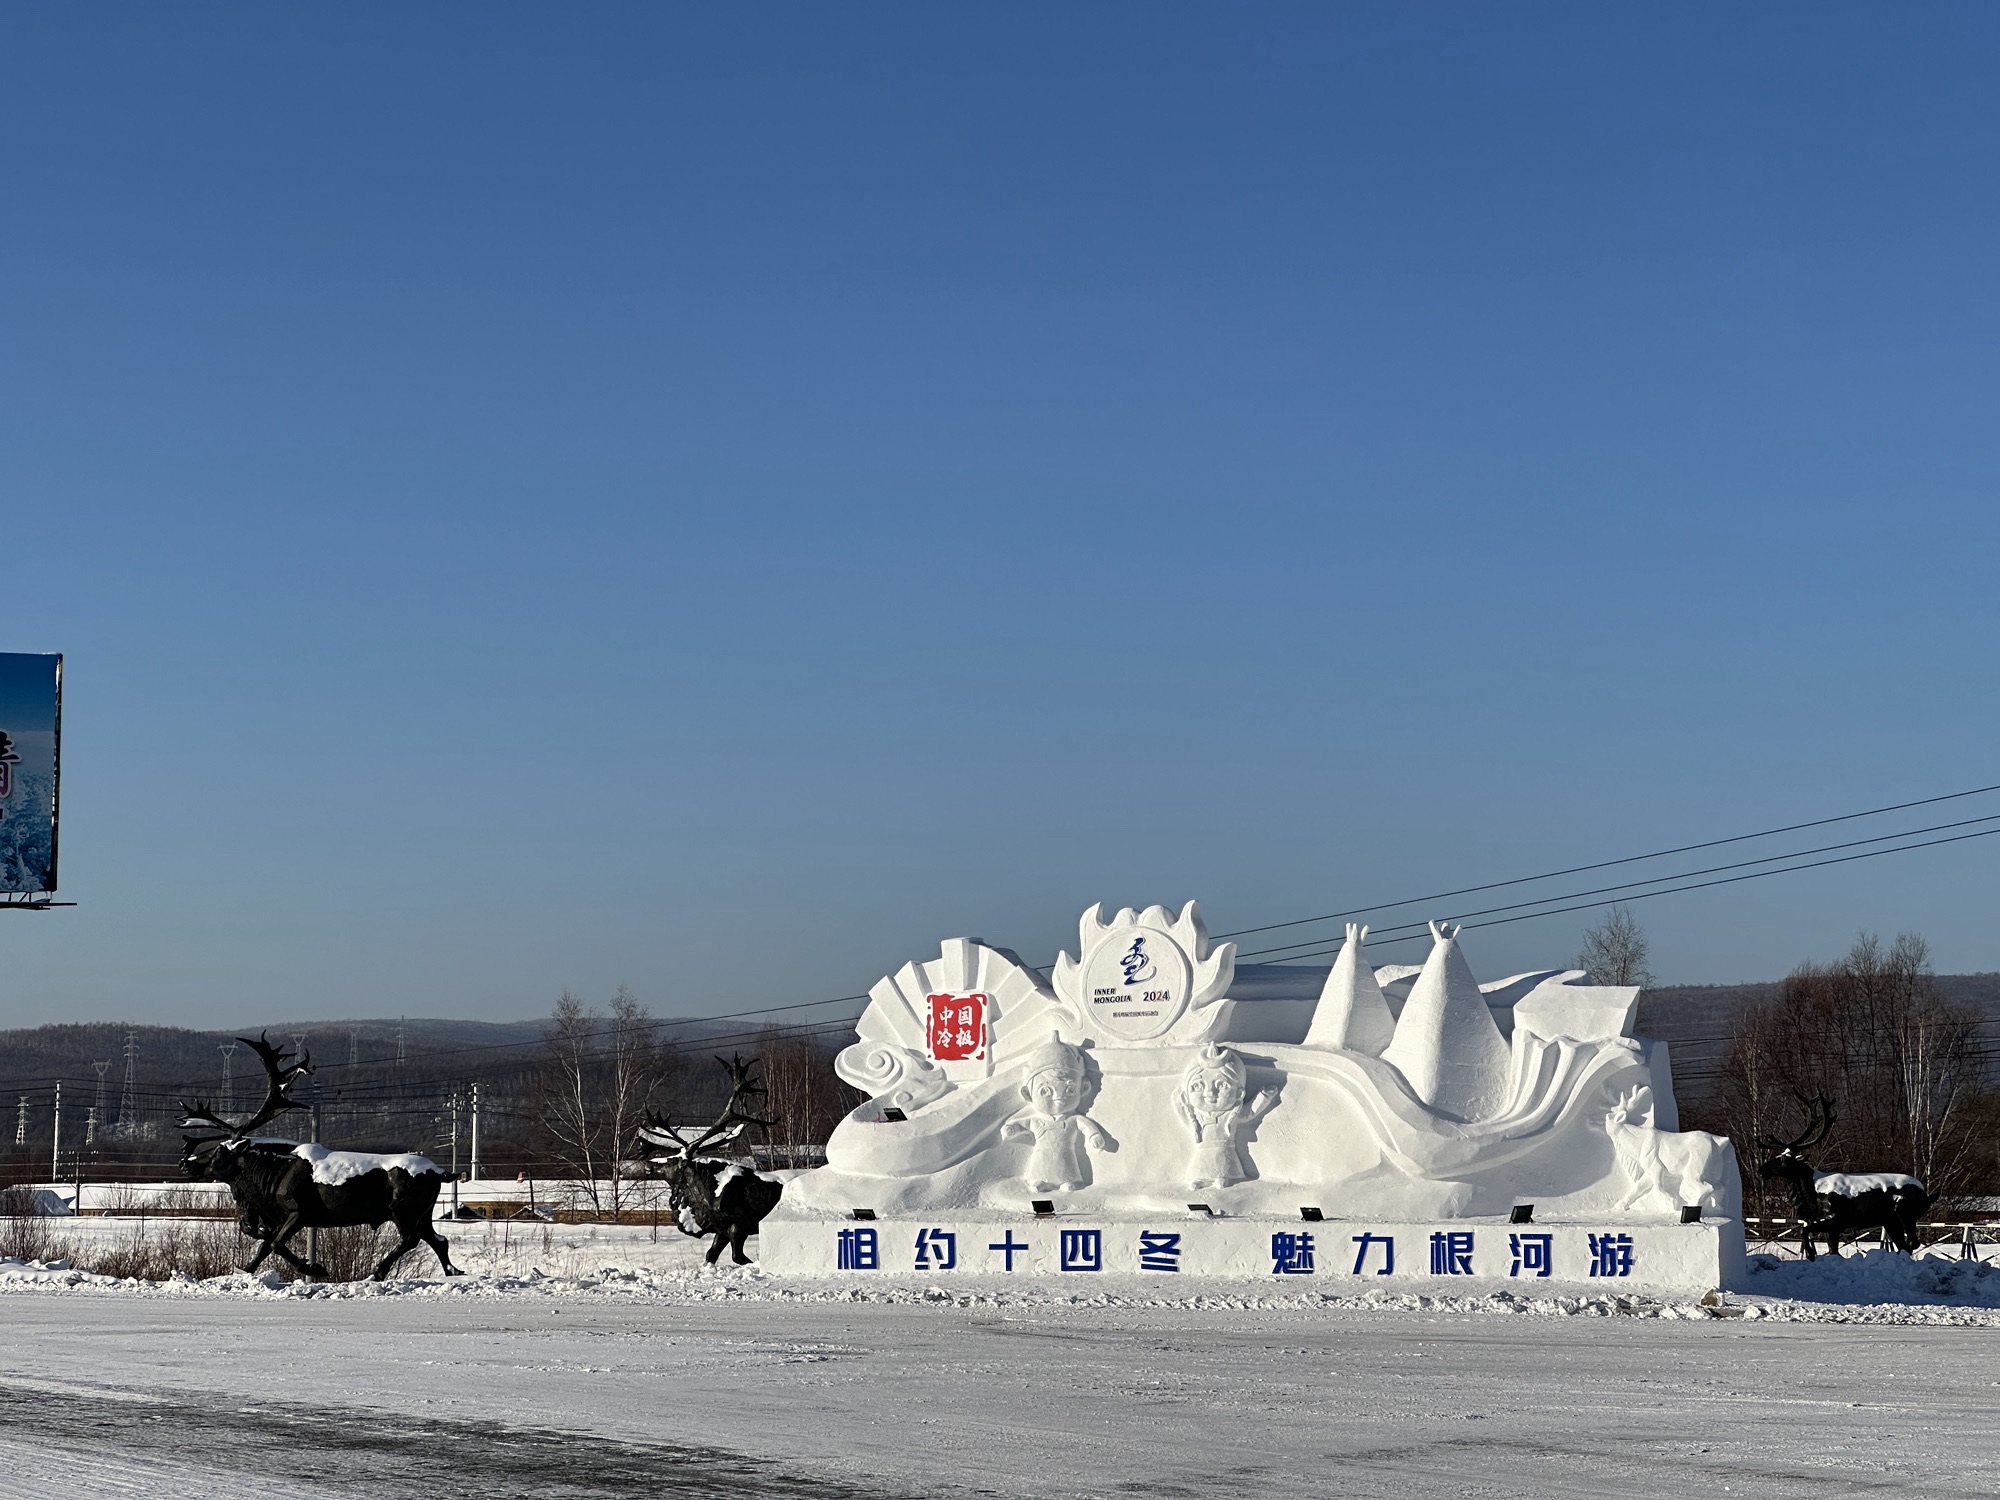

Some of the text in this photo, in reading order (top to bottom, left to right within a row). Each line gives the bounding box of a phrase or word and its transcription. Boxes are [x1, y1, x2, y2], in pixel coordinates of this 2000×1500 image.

[1093, 995, 1132, 1004] MONGOLIA
[1094, 988, 1116, 996] INNER
[1143, 990, 1170, 1002] 2024
[939, 1005, 973, 1027] 中国
[936, 1027, 976, 1049] 冷极
[837, 1228, 1634, 1278] 相约十四冬 魅力根河游
